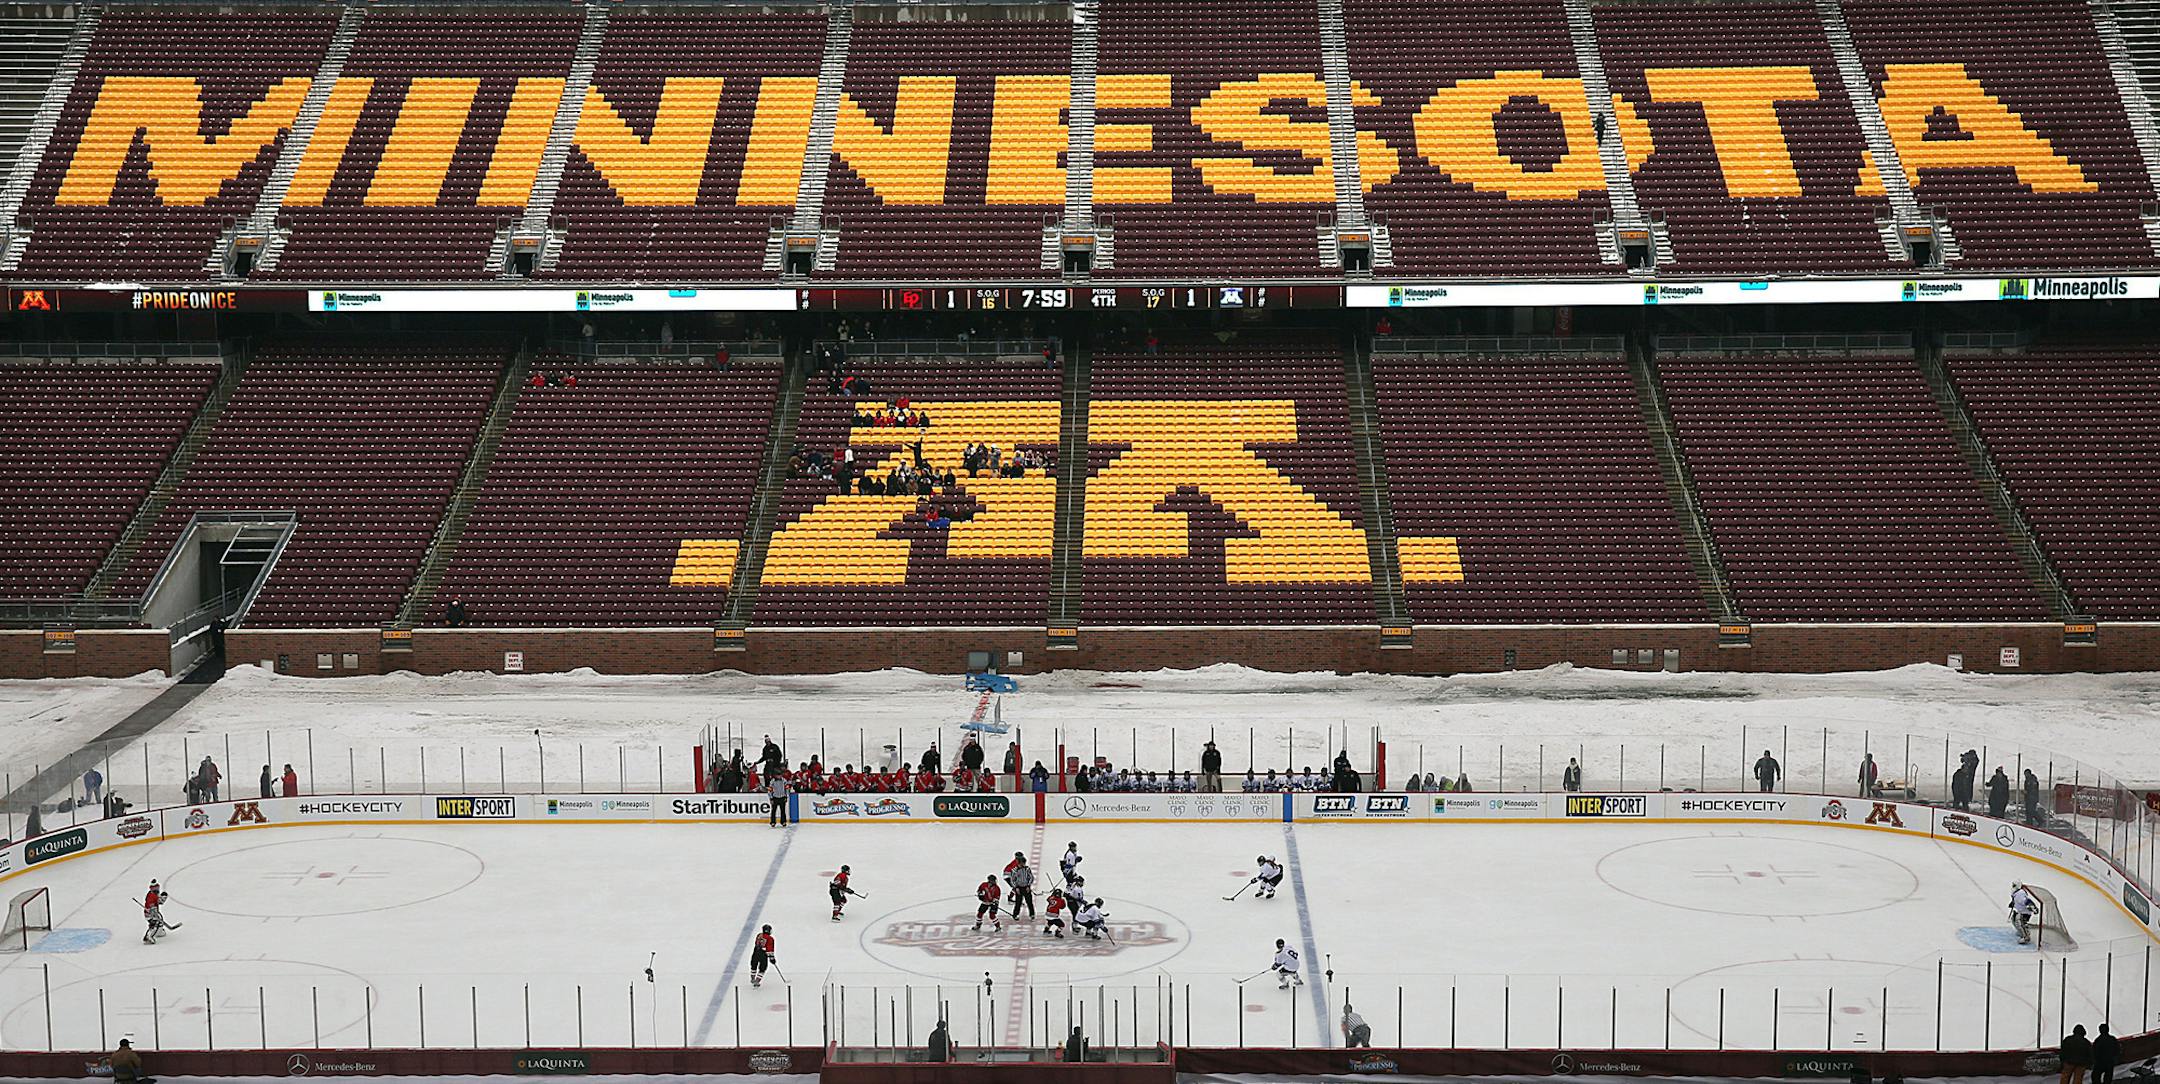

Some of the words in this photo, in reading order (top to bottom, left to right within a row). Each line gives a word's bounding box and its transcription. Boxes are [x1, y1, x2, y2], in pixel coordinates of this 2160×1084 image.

[55, 63, 2100, 207] MINNESOTA
[2033, 278, 2128, 299] Minneapolis
[132, 292, 236, 309] #PRIDEONICE
[948, 290, 955, 309] 1
[982, 298, 995, 309] 16
[1022, 290, 1066, 308] 7:59
[1091, 295, 1116, 307] 4TH
[1147, 296, 1160, 308] 17
[1187, 289, 1195, 307] 1
[299, 802, 403, 814] #HOCKEYCITY
[672, 800, 770, 815] StarTribune
[1091, 804, 1151, 812] Mercedes-Benz
[1317, 798, 1351, 810] BTN
[1369, 798, 1404, 810] BTN
[1682, 800, 1786, 812] #HOCKEYCITY
[2019, 837, 2063, 858] Mercedes-Benz
[315, 1062, 376, 1071] Mercedes-Benz
[1579, 1062, 1641, 1072] Mercedes-Benz
